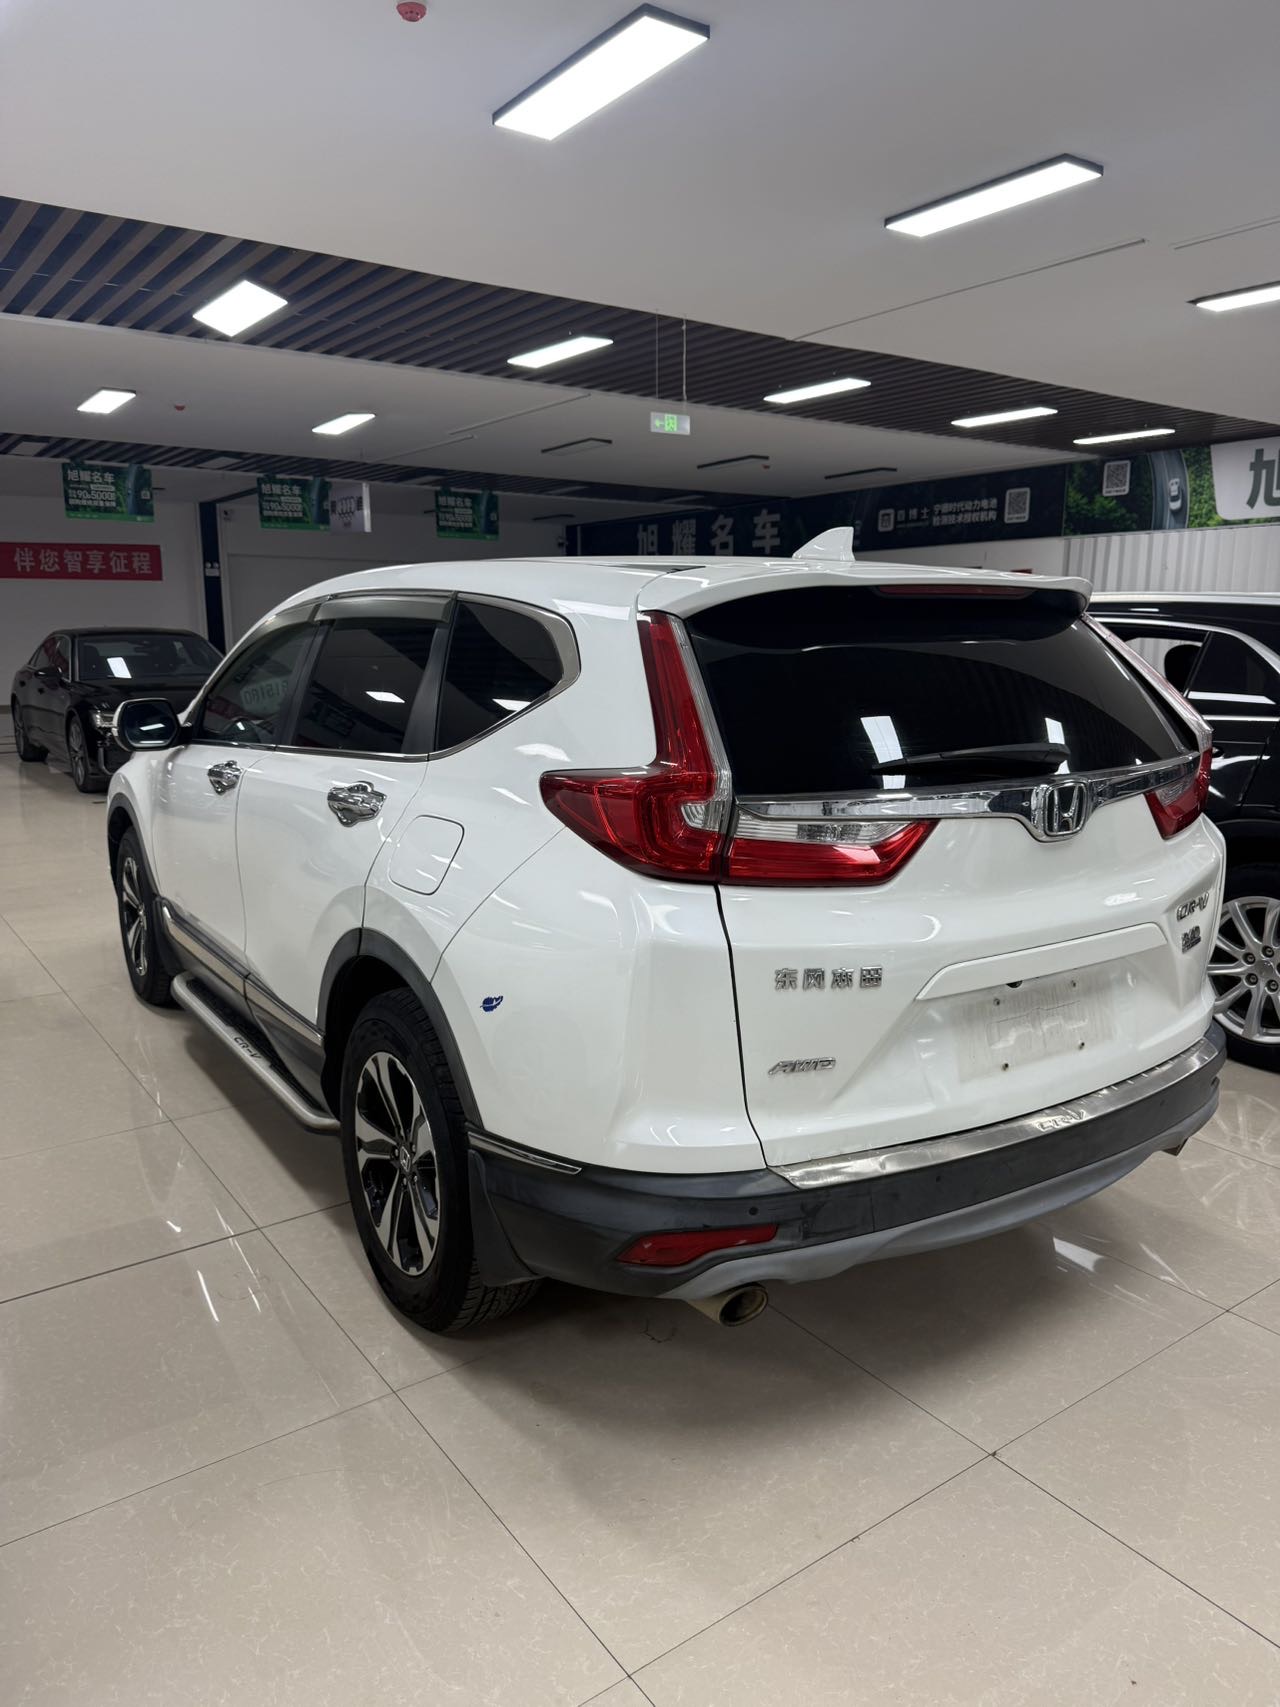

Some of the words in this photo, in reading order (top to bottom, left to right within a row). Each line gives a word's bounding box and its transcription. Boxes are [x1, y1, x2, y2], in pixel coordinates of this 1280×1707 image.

[13, 547, 153, 575] 伴您智享征程
[775, 965, 883, 991] 东风本田
[234, 1036, 261, 1058] CR-V
[768, 1057, 836, 1076] AWD
